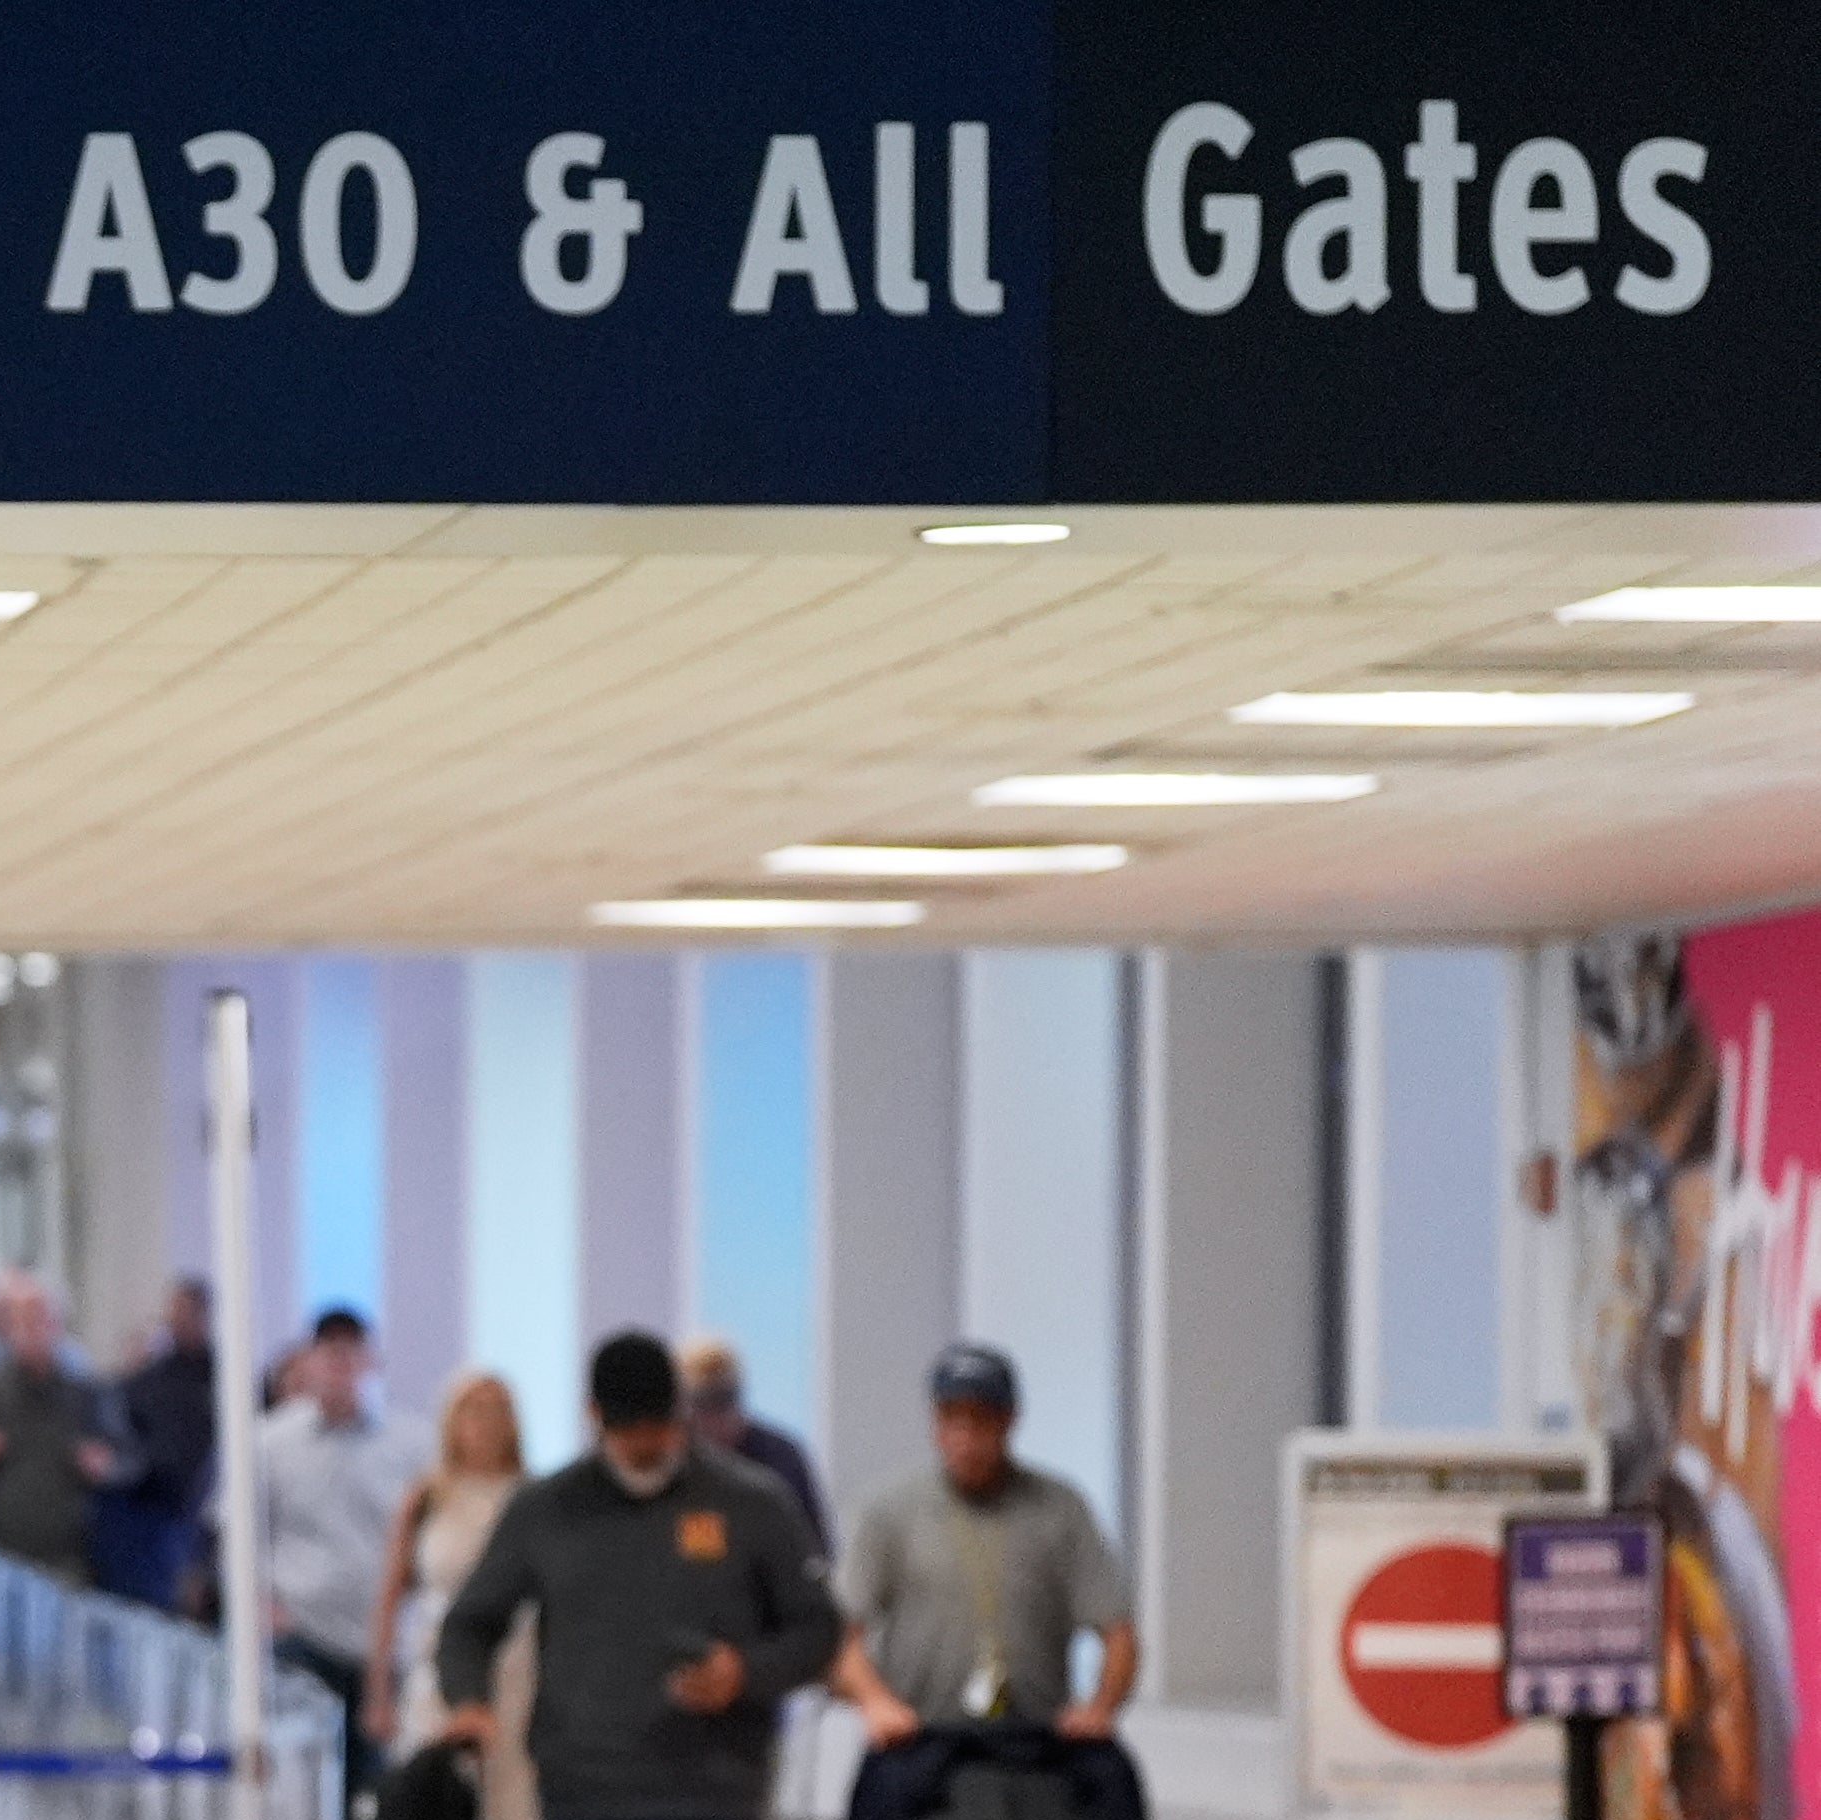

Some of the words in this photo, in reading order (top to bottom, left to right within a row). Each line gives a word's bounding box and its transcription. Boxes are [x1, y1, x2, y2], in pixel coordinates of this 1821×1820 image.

[43, 131, 419, 316] A30
[519, 131, 645, 316] &
[729, 120, 1005, 316] All
[1142, 100, 1713, 317] Gates
